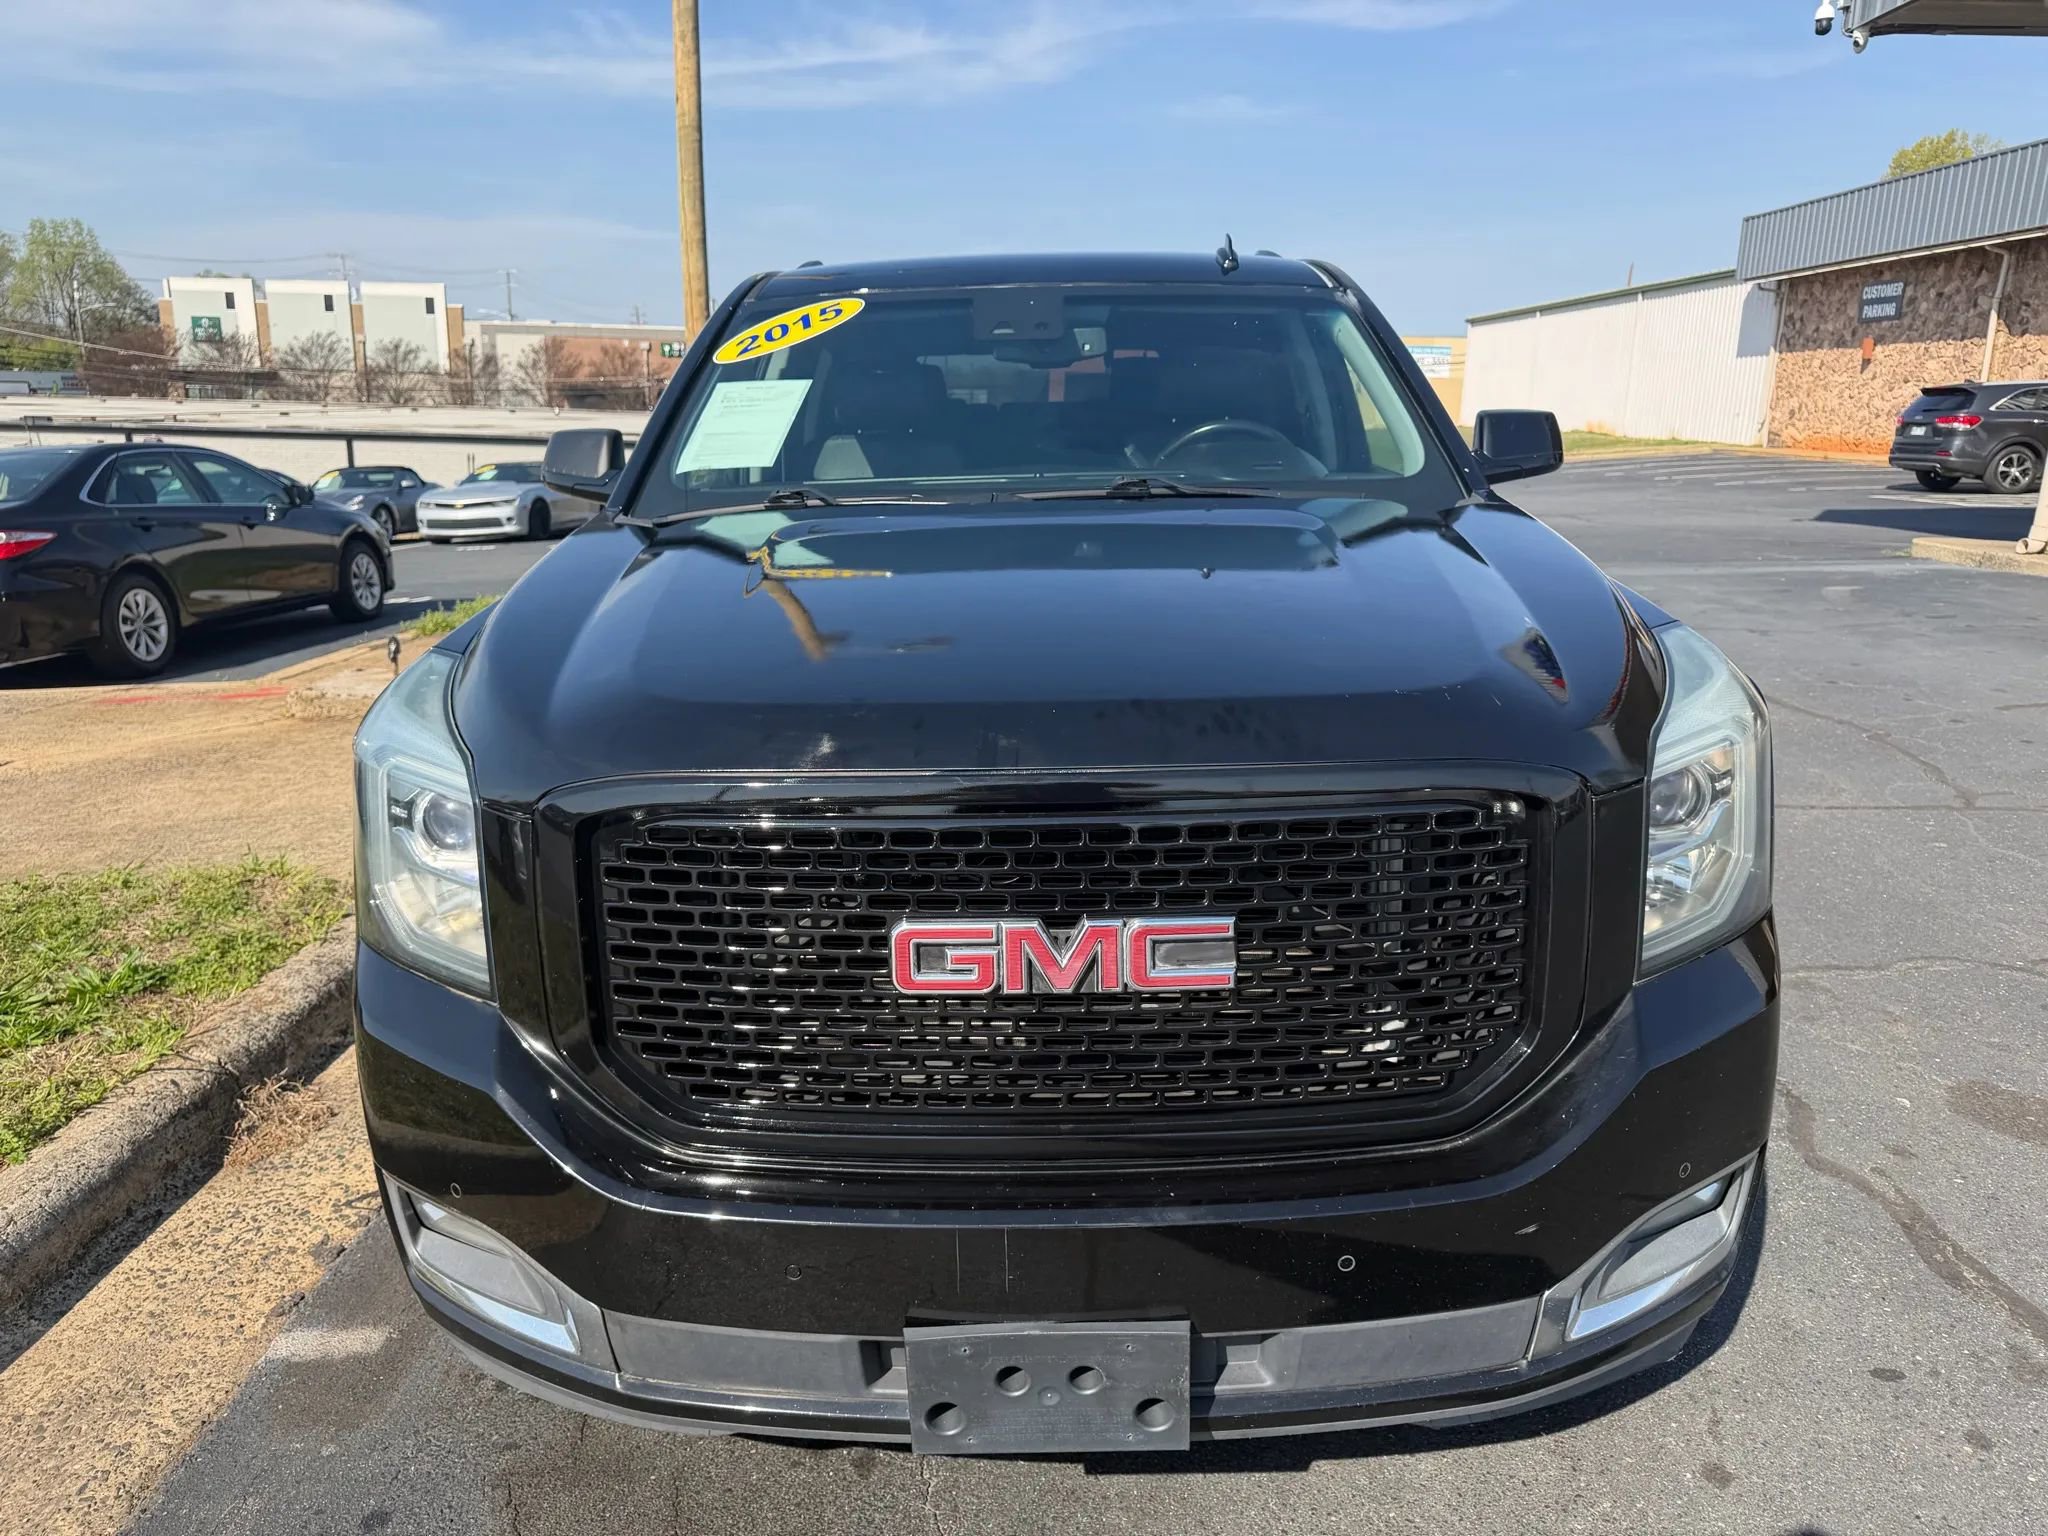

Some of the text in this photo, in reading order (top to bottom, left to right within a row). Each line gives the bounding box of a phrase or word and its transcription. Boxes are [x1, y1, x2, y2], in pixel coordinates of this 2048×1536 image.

[1862, 281, 1904, 300] CUSTOMER
[1862, 302, 1896, 319] PARKING
[735, 302, 843, 358] 2015
[892, 914, 1236, 995] GMC
